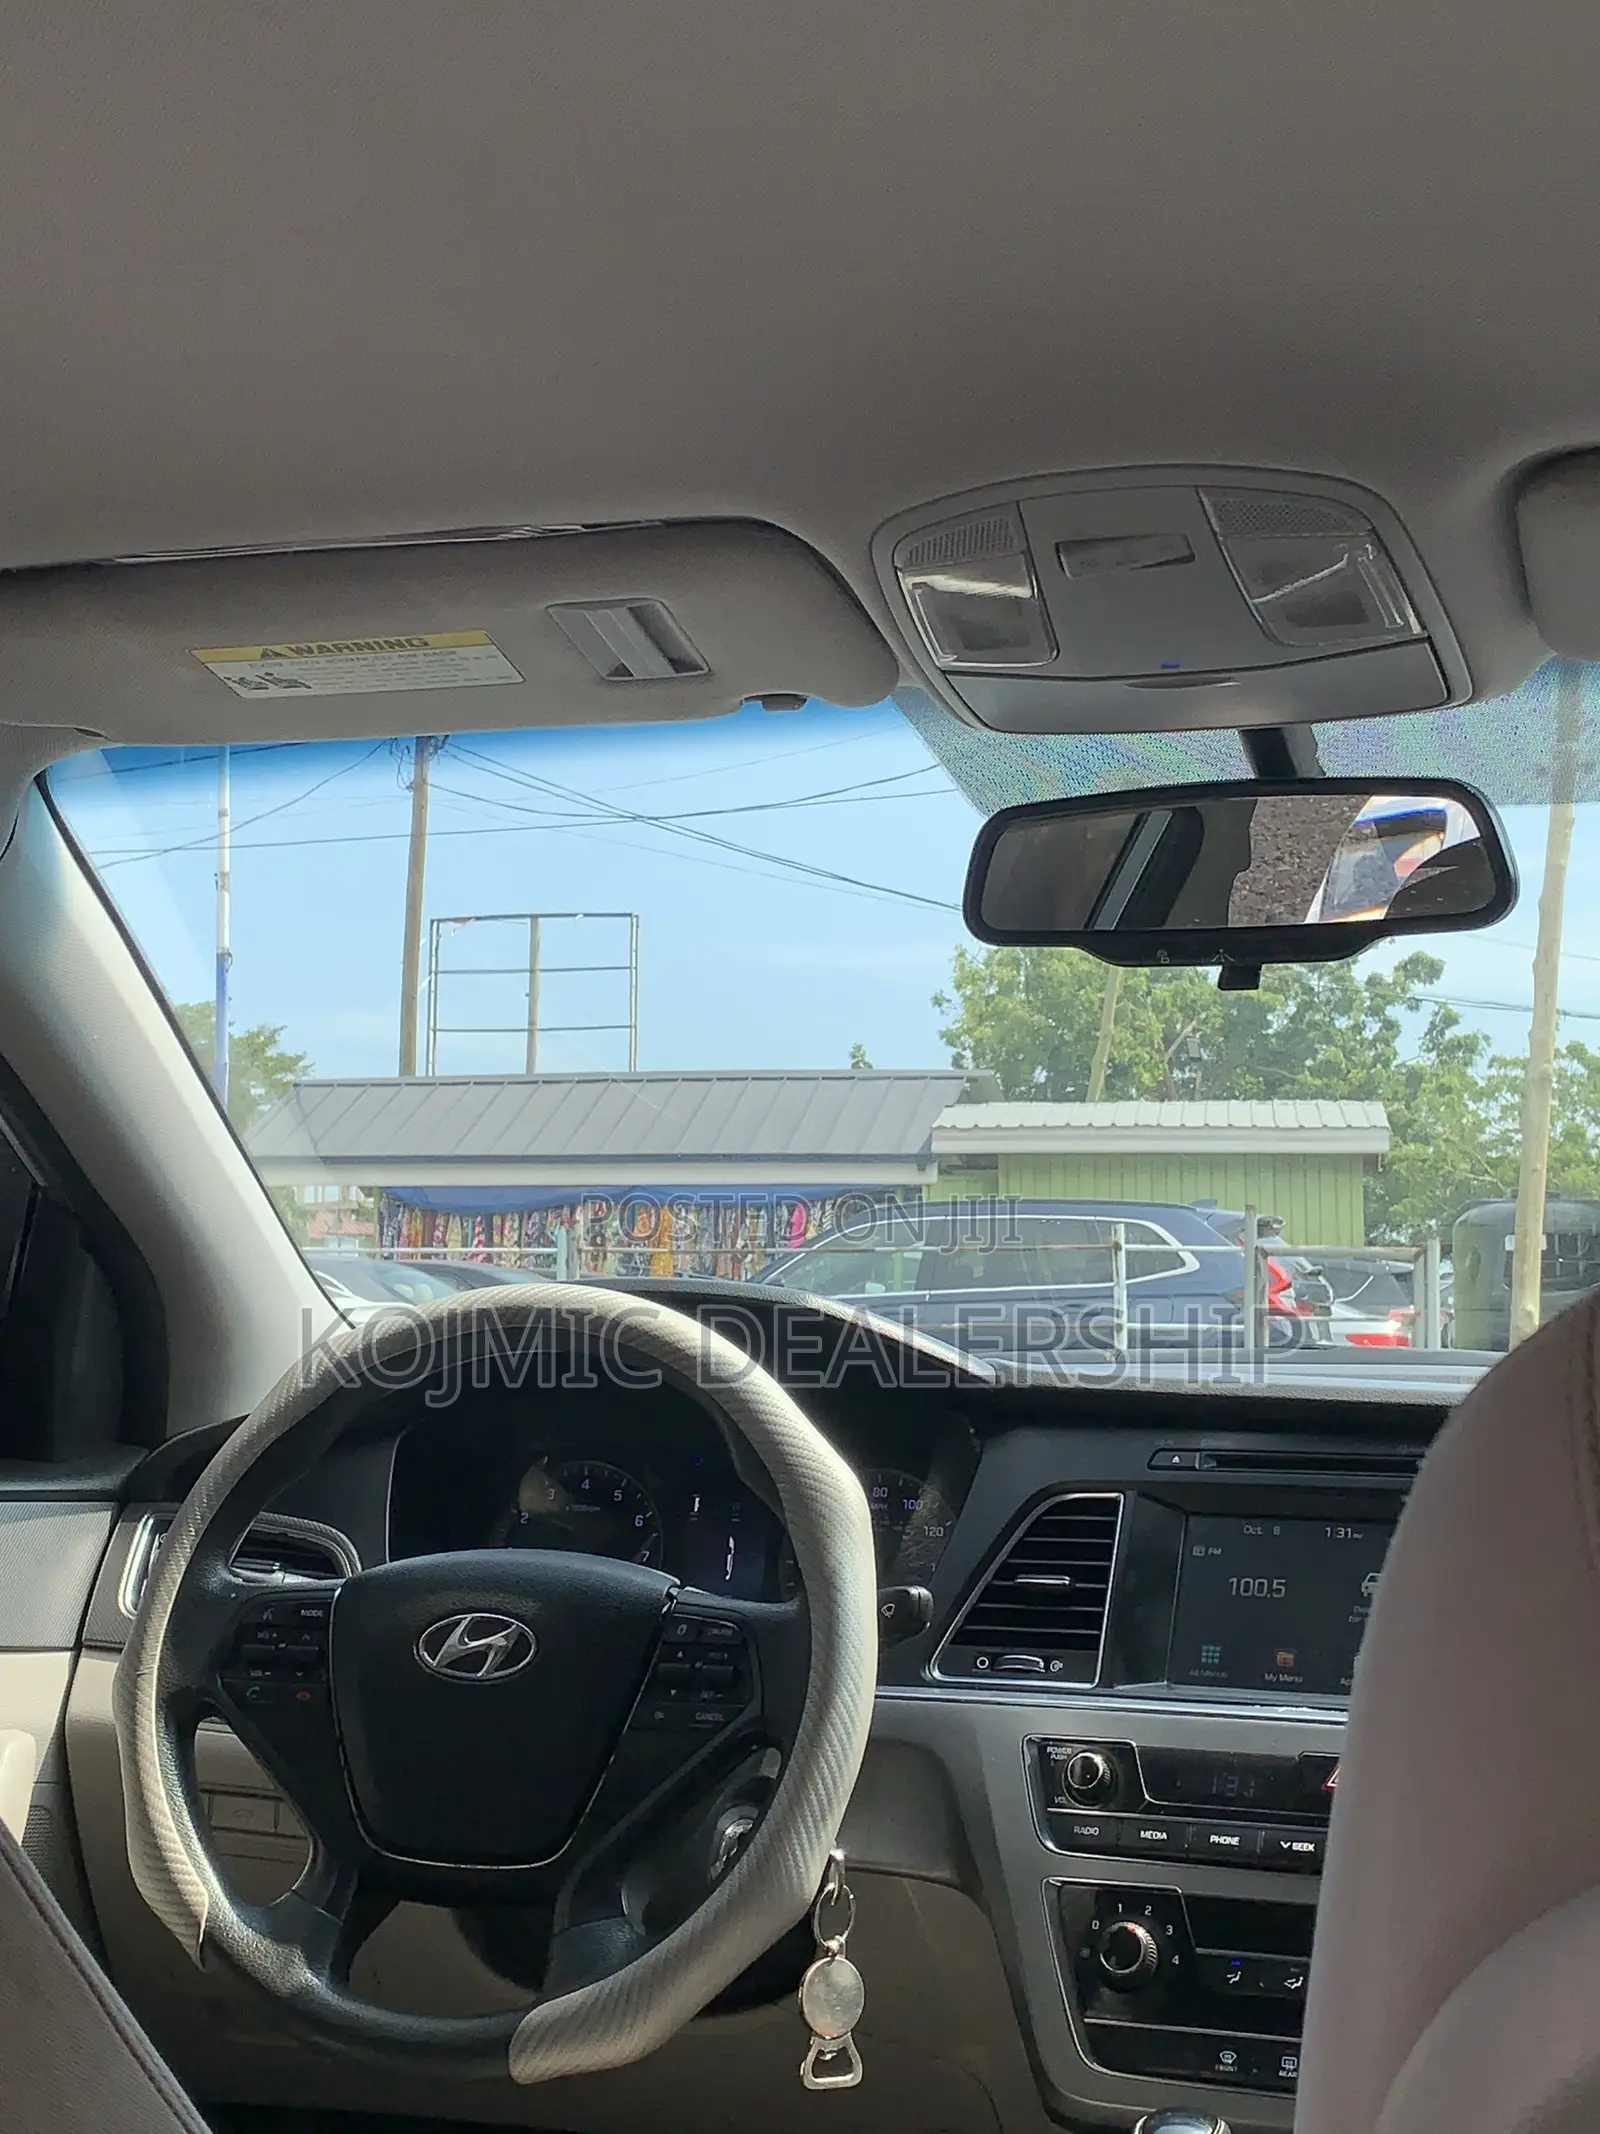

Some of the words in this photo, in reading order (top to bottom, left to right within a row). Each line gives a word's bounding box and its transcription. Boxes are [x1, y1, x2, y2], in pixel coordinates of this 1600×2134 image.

[286, 637, 430, 659] WARNING
[581, 1479, 590, 1490] 4
[548, 1489, 556, 1500] 3
[614, 1490, 622, 1501] 5
[872, 1487, 888, 1498] 80
[903, 1499, 923, 1510] 100
[520, 1512, 529, 1524] 2
[635, 1515, 644, 1527] 6
[924, 1526, 944, 1537] 120
[642, 1550, 650, 1562] 7
[1229, 1577, 1287, 1598] 100.5
[1264, 1672, 1278, 1683] My
[1279, 1672, 1303, 1684] Menu
[1046, 1747, 1072, 1755] POWER
[1074, 1825, 1100, 1836] RADIO
[1140, 1830, 1168, 1841] MEDIA
[1210, 1835, 1240, 1846] PHONE
[1292, 1842, 1315, 1852] SEEK
[1118, 1903, 1123, 1913] 1
[1144, 1905, 1152, 1916] 2
[1165, 1925, 1173, 1935] 3
[1172, 1955, 1180, 1965] 4
